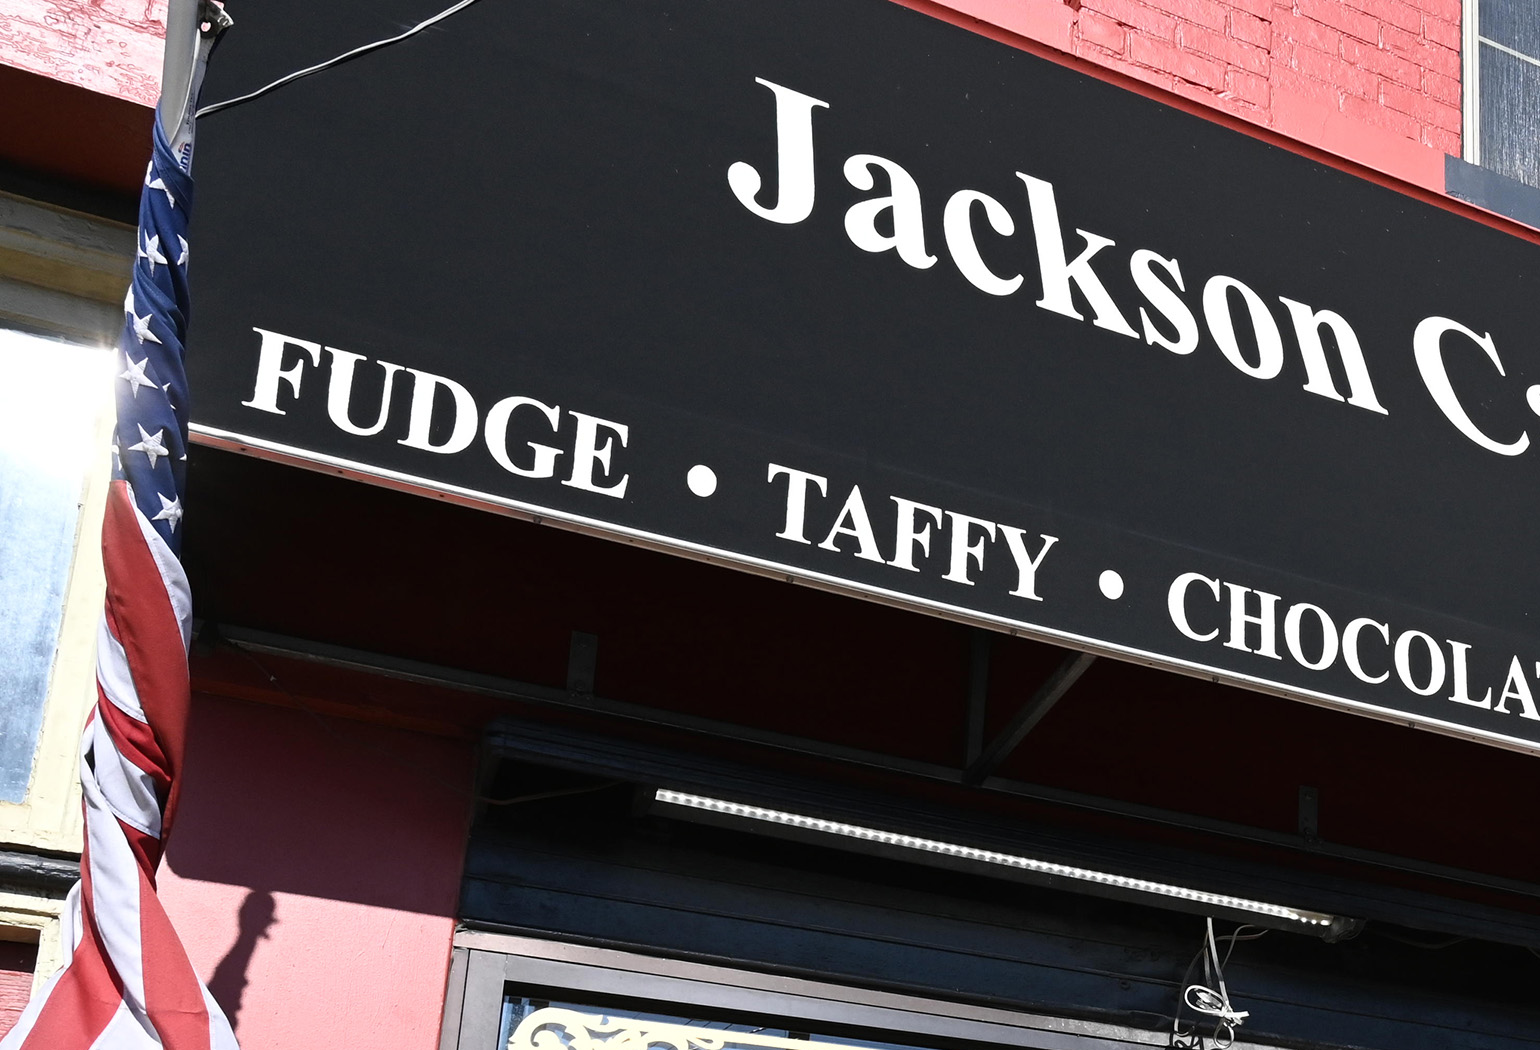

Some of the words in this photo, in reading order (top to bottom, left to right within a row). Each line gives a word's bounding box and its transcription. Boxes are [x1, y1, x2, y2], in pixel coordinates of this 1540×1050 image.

[728, 76, 1389, 415] Jackson
[241, 326, 630, 499] FUDGE
[767, 463, 1060, 604] TAFFY
